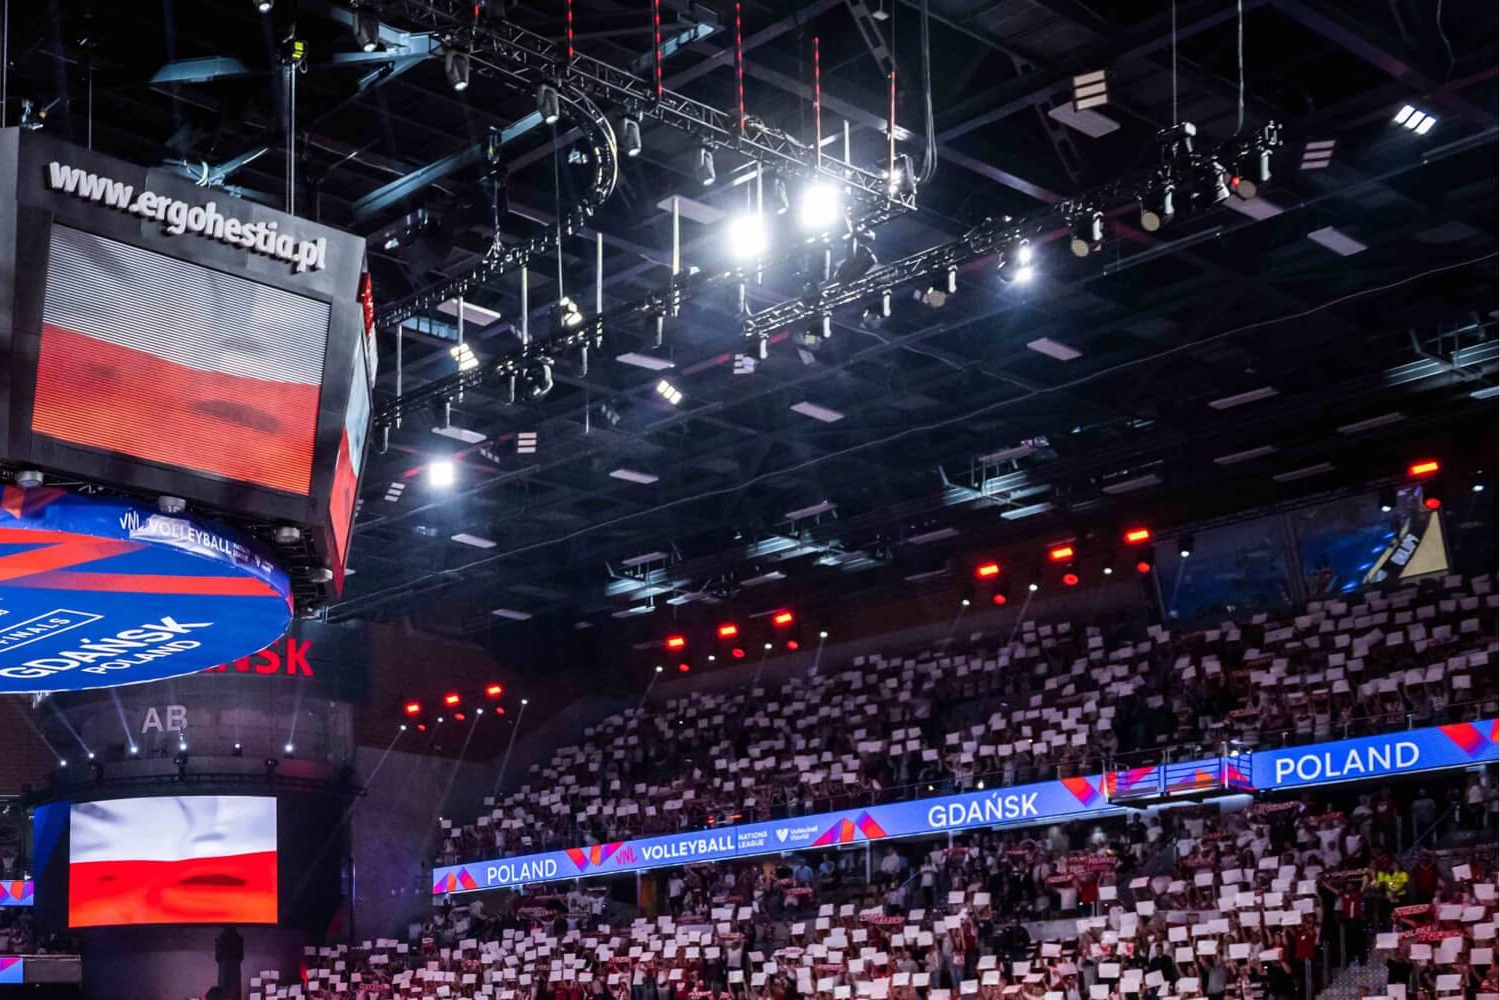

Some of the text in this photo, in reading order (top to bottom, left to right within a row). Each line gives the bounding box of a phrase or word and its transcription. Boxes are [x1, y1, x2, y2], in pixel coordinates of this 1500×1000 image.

[49, 161, 327, 273] www.ergohestia.pl
[150, 520, 232, 554] VOLLEYBALL
[81, 639, 202, 675] POLAND
[141, 704, 188, 733] AB
[1274, 742, 1420, 784] POLAND
[927, 792, 1039, 828] GDAŃSK
[641, 835, 736, 861] VOLLEYBALL
[738, 830, 769, 842] NATIONS
[738, 838, 765, 848] LEAGUE
[486, 858, 558, 886] POLAND
